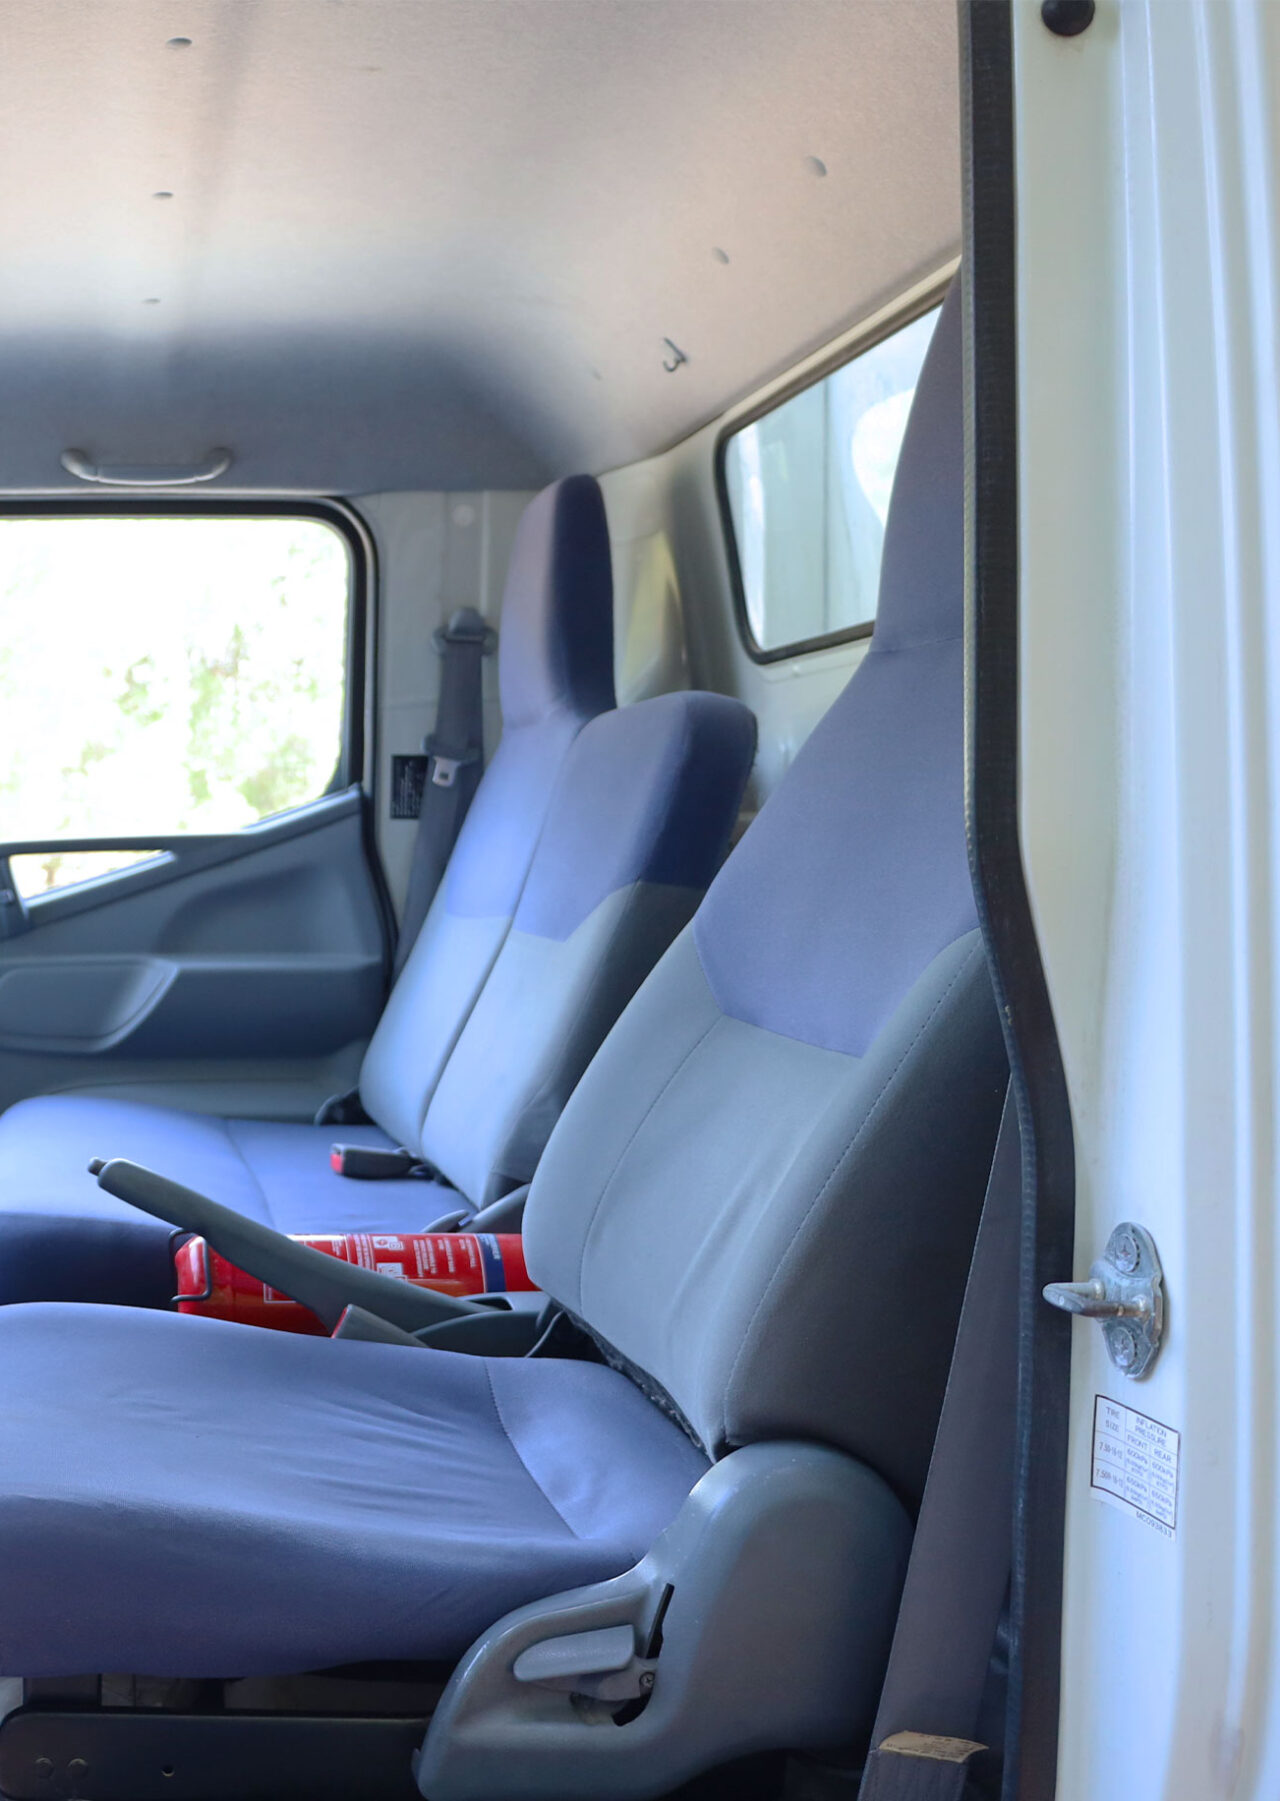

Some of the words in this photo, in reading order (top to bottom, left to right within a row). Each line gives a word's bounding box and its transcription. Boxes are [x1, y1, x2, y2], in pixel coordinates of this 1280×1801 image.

[1105, 1420, 1119, 1432] SIZE
[1127, 1434, 1148, 1450] FRONT
[1153, 1448, 1172, 1463] REAR
